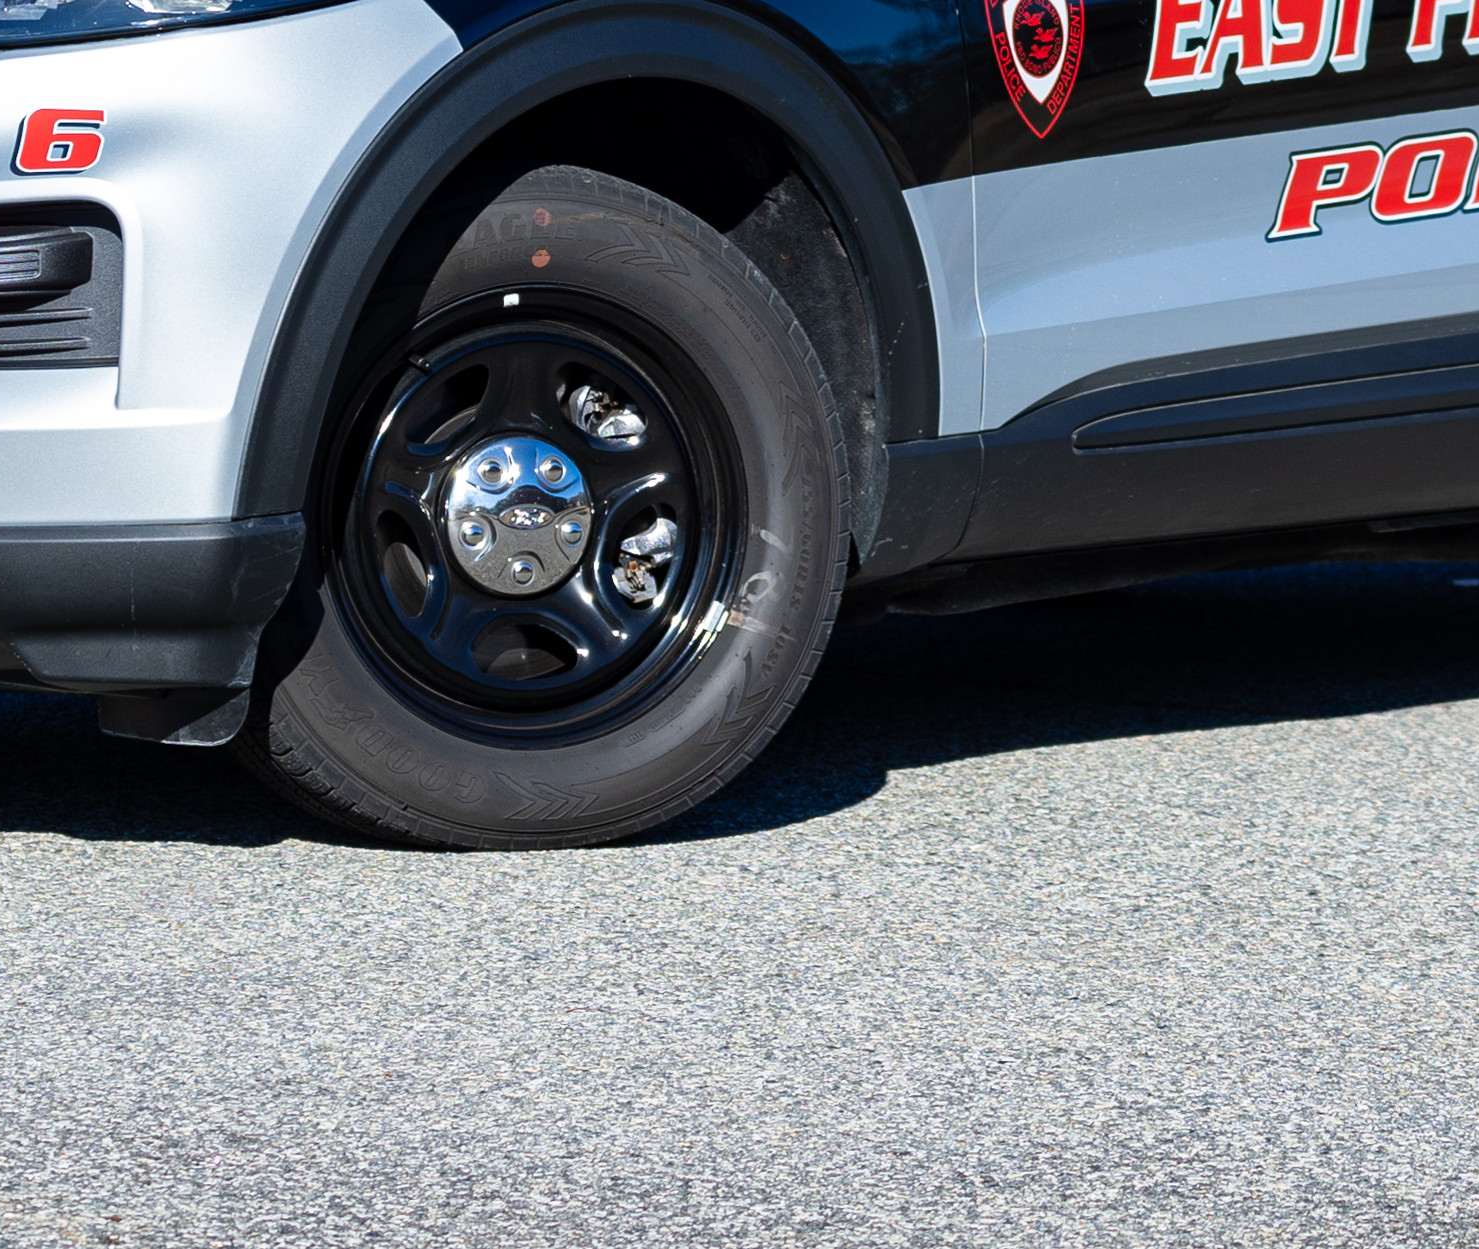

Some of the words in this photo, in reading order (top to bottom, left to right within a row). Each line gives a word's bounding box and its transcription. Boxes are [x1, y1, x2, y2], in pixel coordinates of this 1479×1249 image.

[994, 32, 1026, 102] POLICE
[1047, 3, 1082, 115] DEPARTMENT
[11, 108, 105, 176] 6
[454, 213, 576, 256] AGLE
